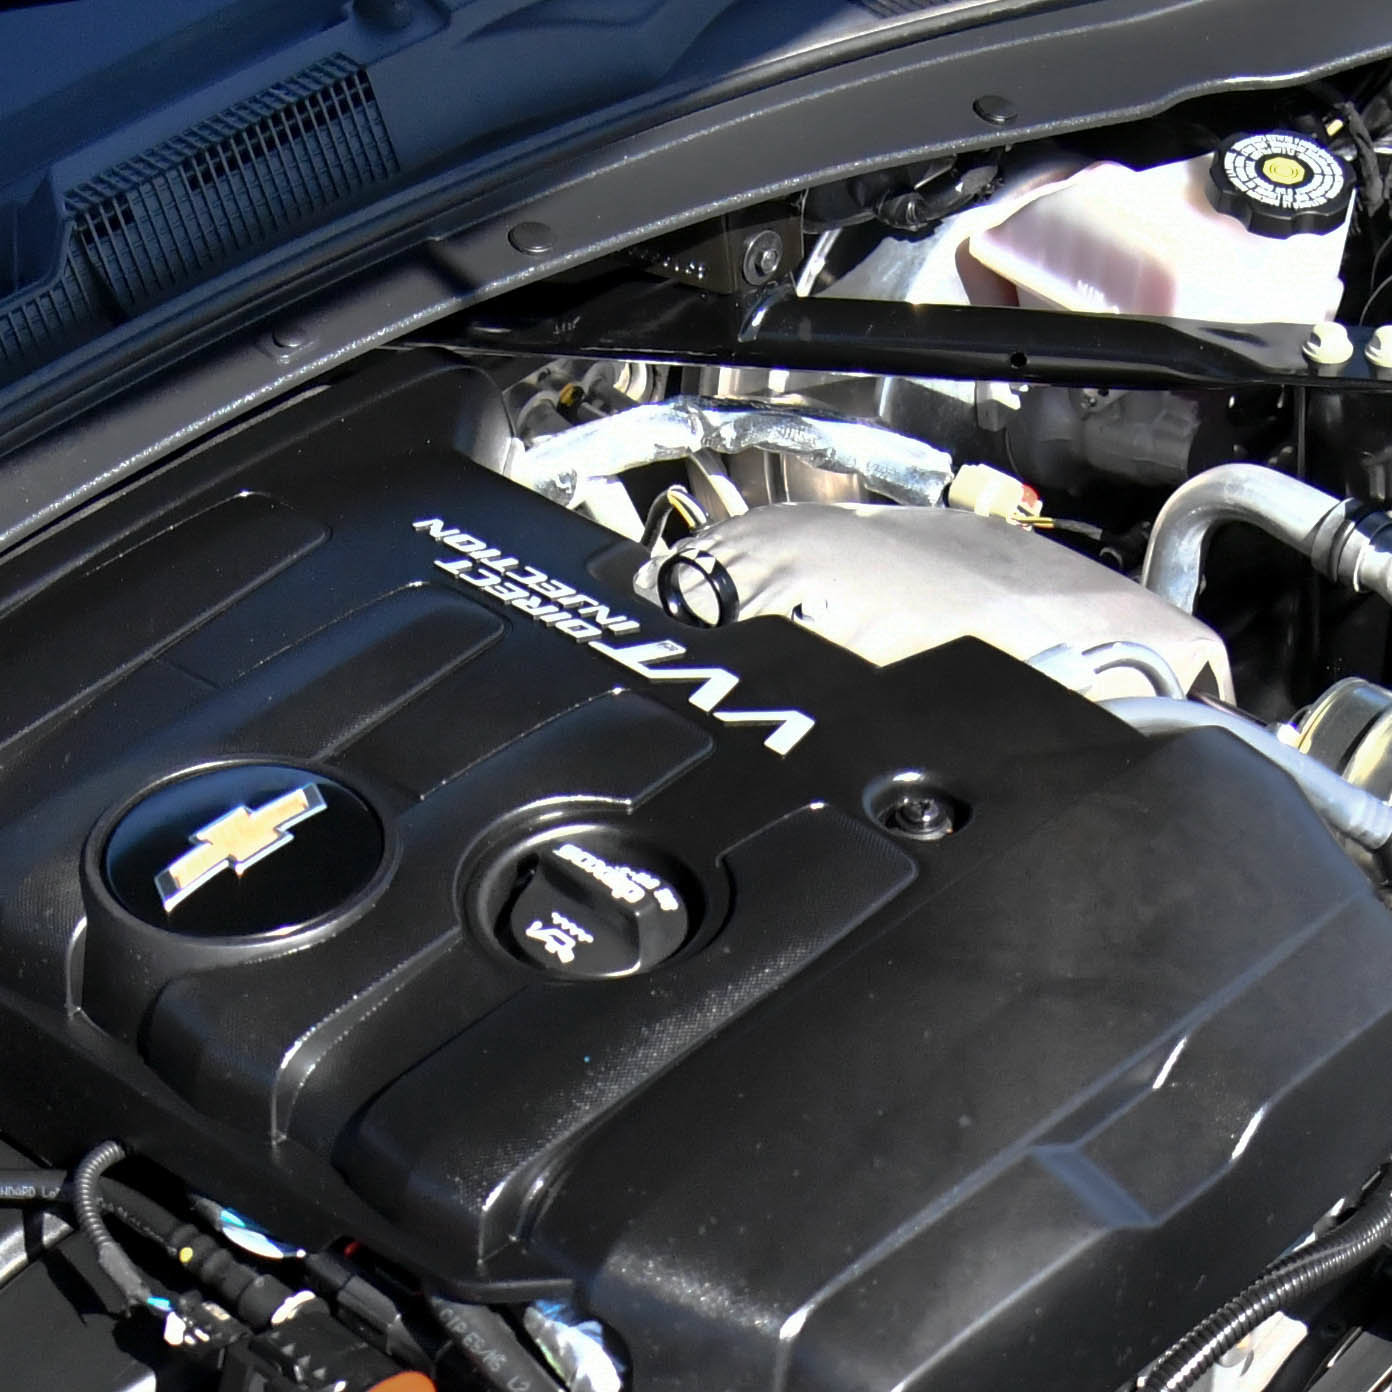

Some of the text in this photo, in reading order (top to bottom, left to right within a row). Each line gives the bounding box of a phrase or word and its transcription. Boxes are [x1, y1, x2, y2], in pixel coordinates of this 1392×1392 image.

[412, 518, 640, 635] INJECTION
[434, 557, 603, 642] DIRECT
[588, 639, 816, 757] VVT
